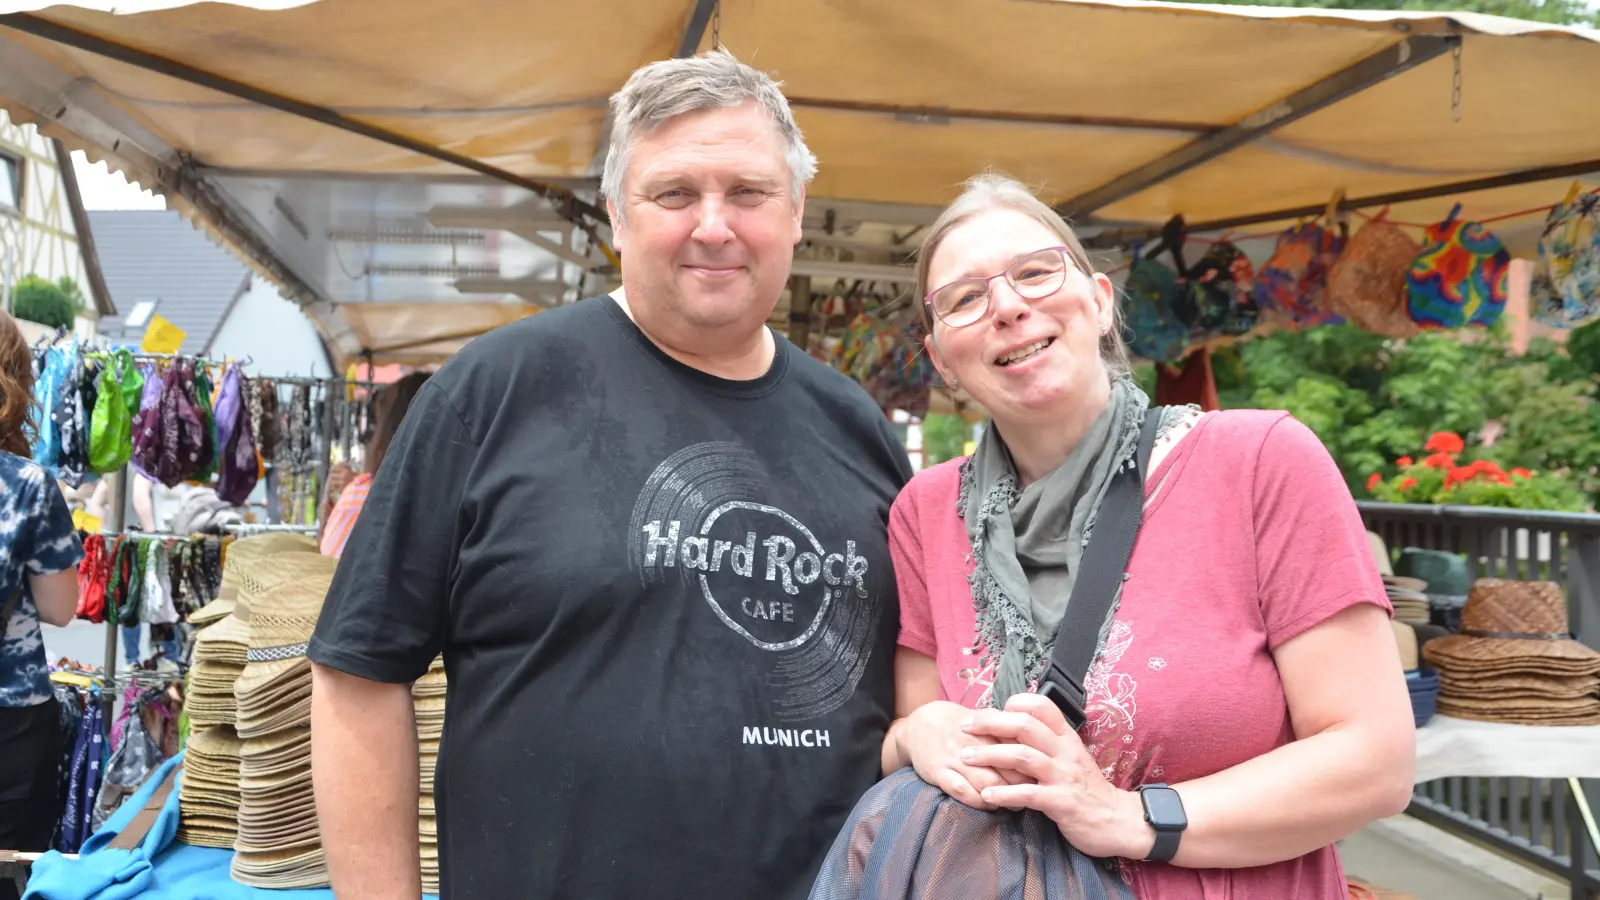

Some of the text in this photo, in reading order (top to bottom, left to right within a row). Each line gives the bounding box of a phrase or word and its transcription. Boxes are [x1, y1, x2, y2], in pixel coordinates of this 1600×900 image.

[642, 520, 869, 598] Hard Rock
[741, 597, 795, 623] CAFE
[742, 726, 831, 748] MUNICH
